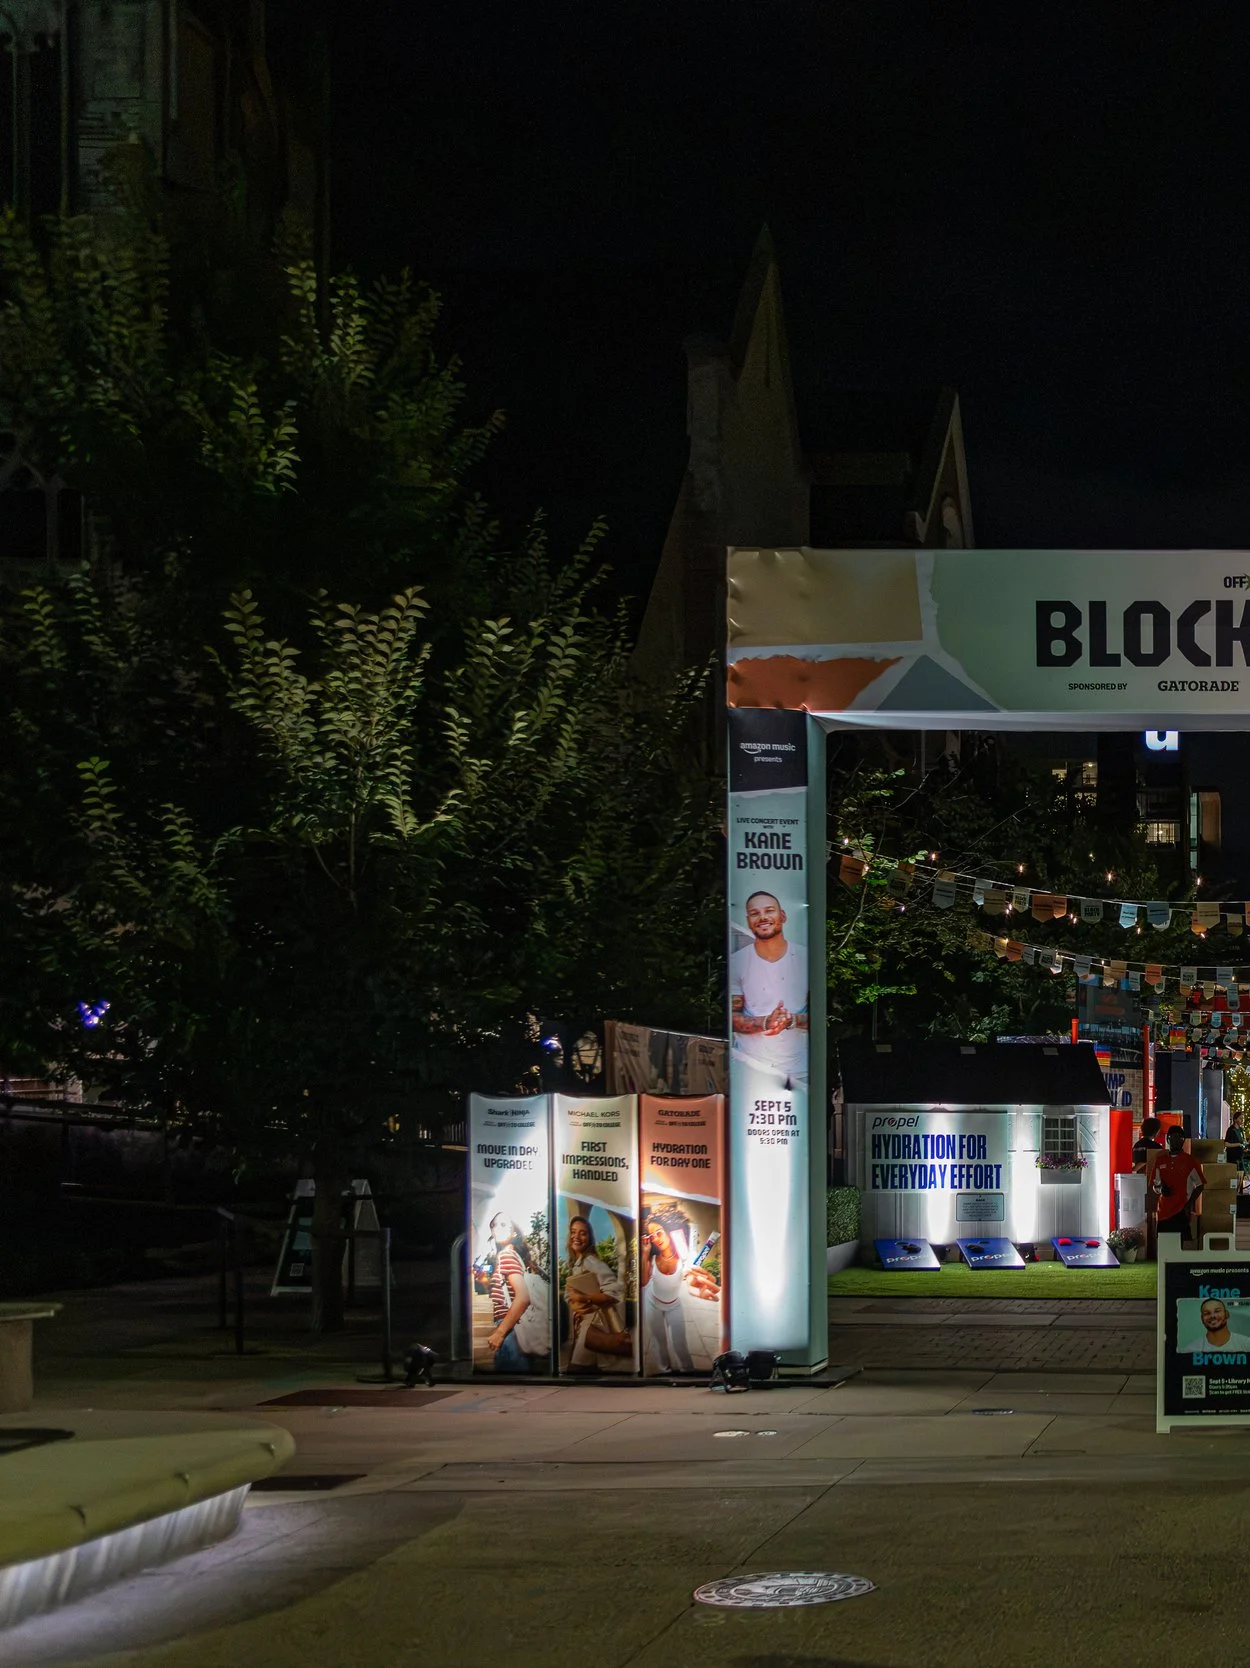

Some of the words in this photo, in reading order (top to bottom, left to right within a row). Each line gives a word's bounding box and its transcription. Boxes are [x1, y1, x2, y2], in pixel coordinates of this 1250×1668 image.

[1223, 576, 1246, 588] OFF
[1068, 682, 1116, 691] SPONSORED
[1117, 682, 1128, 690] BY
[1157, 680, 1239, 692] GATORADE
[740, 742, 771, 752] amazon
[772, 742, 796, 751] music
[745, 832, 792, 850] KANE
[737, 852, 803, 871] BROWN
[755, 1100, 781, 1112] SEPT
[784, 1101, 792, 1112] 5
[567, 1110, 599, 1118] MICHAEL
[658, 1109, 701, 1117] GATORADE
[749, 1113, 775, 1125] 7:30
[778, 1114, 797, 1126] PM
[872, 1116, 919, 1130] propel
[477, 1144, 508, 1156] MOVE
[508, 1145, 518, 1156] IN
[581, 1141, 607, 1153] FIRST
[652, 1142, 708, 1155] HYDRATION
[872, 1134, 956, 1160] HYDRATION
[959, 1133, 987, 1160] FOR
[562, 1154, 629, 1170] IMPRESSIONS,
[650, 1155, 671, 1166] FOR
[672, 1156, 690, 1168] DAY
[691, 1157, 711, 1169] ONE
[573, 1169, 618, 1182] HANDLED
[872, 1164, 947, 1190] EVERYDAY
[950, 1164, 1002, 1190] EFFORT
[1199, 1284, 1241, 1299] Kane
[1192, 1352, 1248, 1366] Brown
